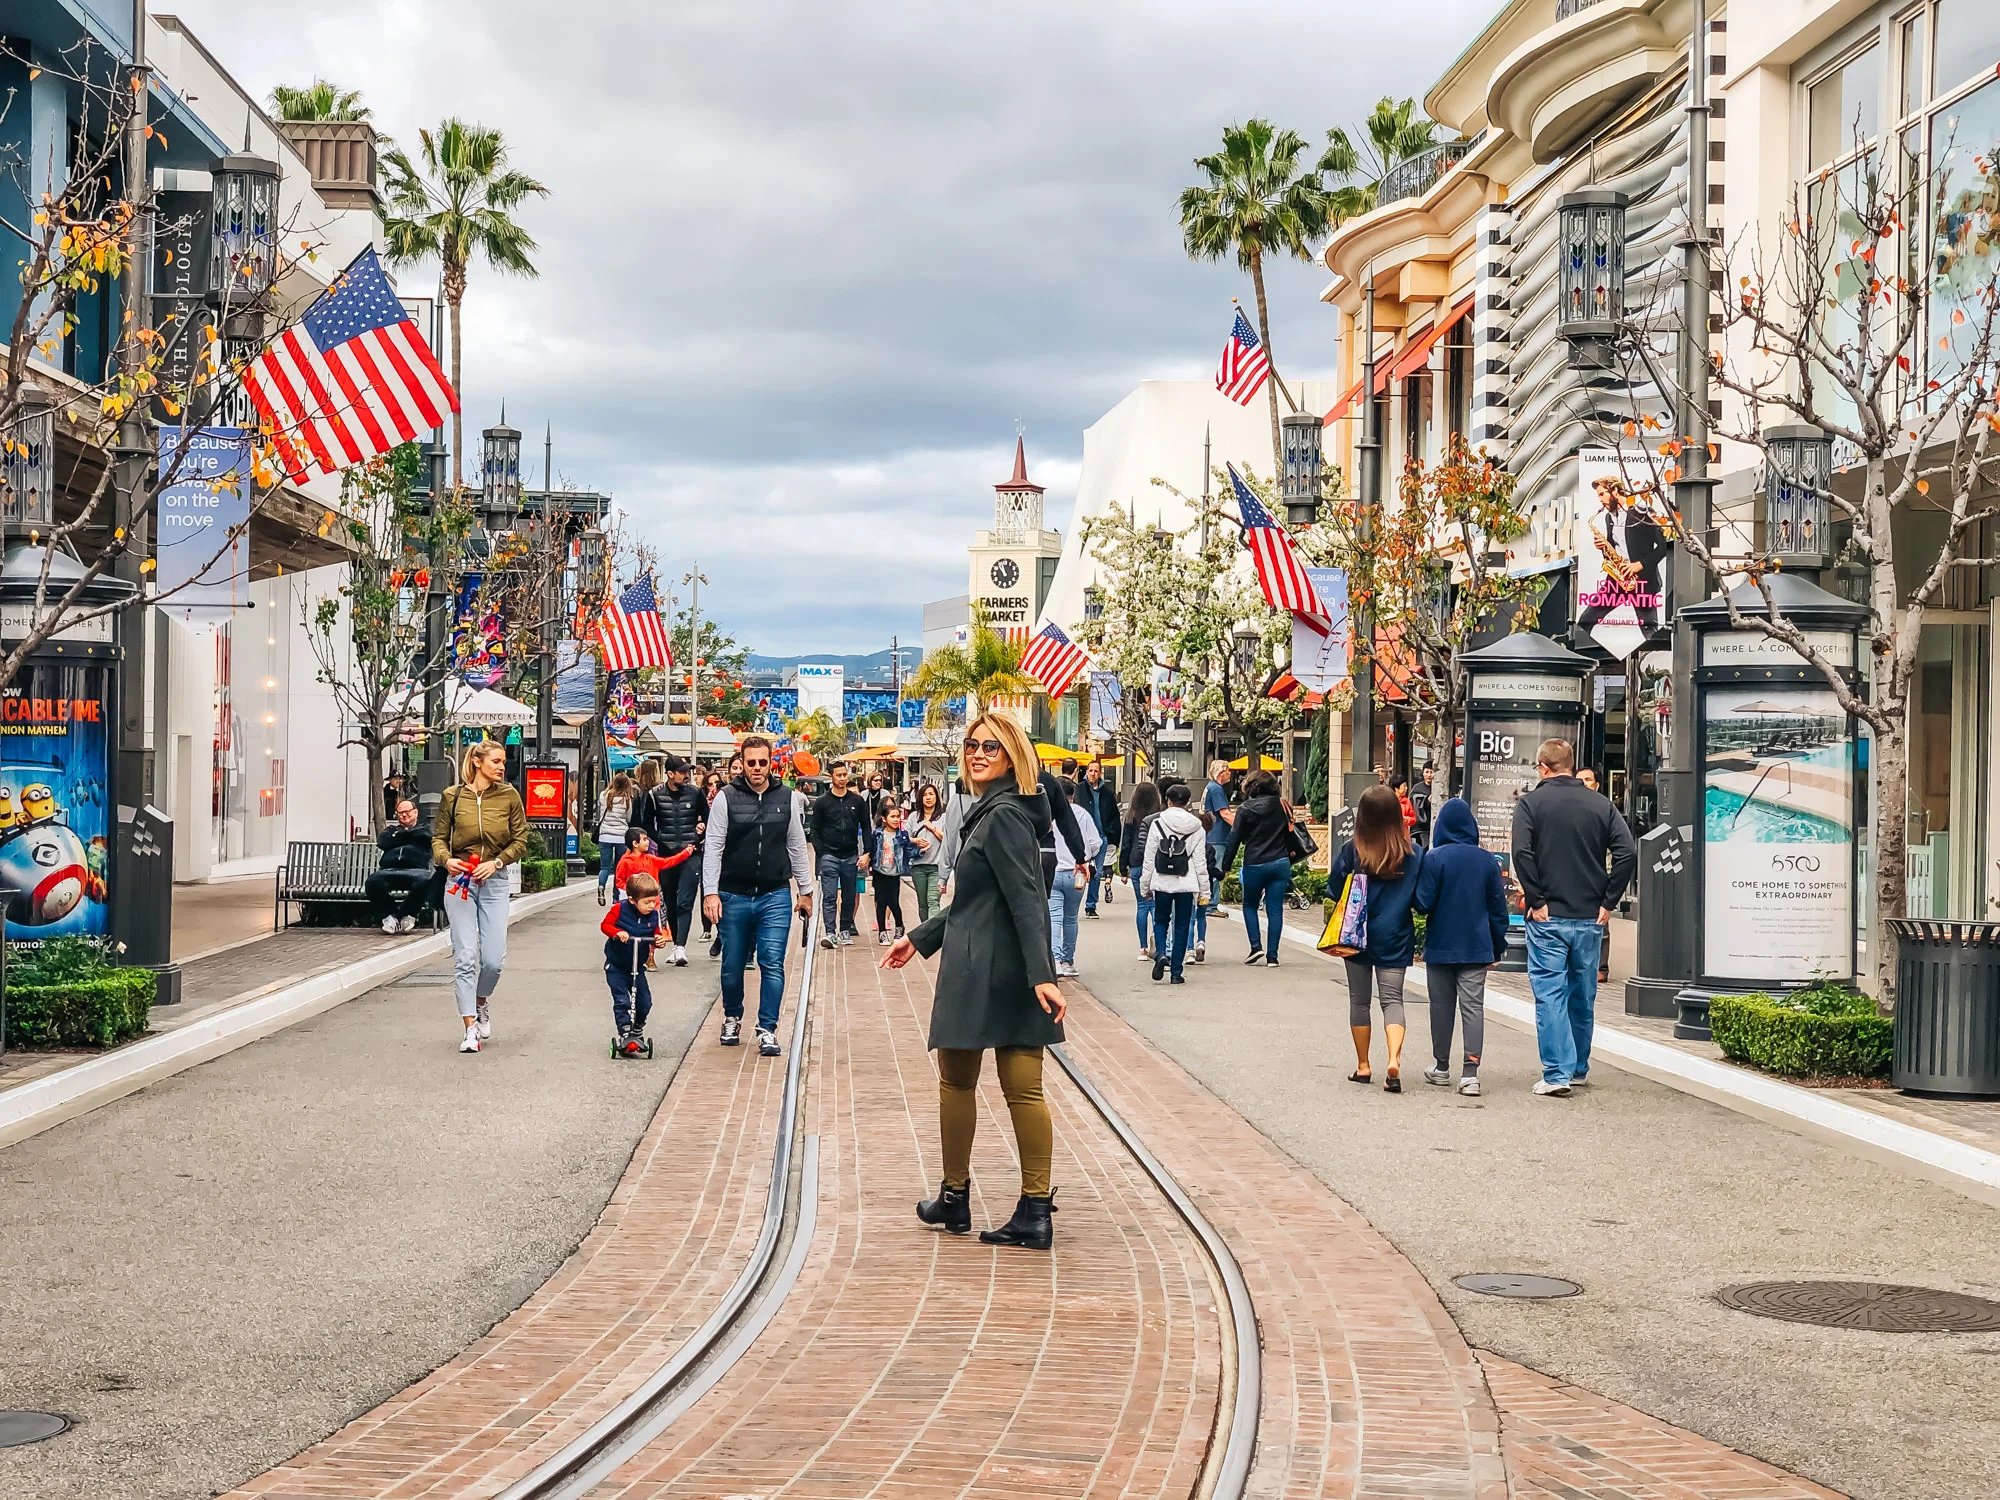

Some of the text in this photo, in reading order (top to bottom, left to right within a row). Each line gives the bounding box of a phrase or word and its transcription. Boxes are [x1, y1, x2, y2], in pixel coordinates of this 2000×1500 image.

[1585, 455, 1605, 463] LIAM
[165, 492, 220, 508] on the
[165, 514, 214, 526] move
[1635, 579, 1648, 593] IT
[980, 597, 1029, 608] FARMERS
[1579, 593, 1663, 608] ROMANTIC
[981, 611, 1026, 622] MARKET
[1711, 644, 1744, 653] WHERE
[799, 667, 832, 675] IMAX
[74, 699, 100, 722] ME
[463, 712, 504, 720] GIVING
[506, 712, 527, 720] KEYS
[27, 726, 67, 736] MAYHEM
[1480, 730, 1515, 759] Big
[1490, 753, 1503, 762] the
[1160, 757, 1177, 772] Big
[1479, 762, 1495, 771] little
[1479, 776, 1495, 784] Even
[1731, 881, 1758, 889] COME
[1762, 881, 1790, 889] HOME
[1755, 891, 1833, 899] EXTRAORDINARY
